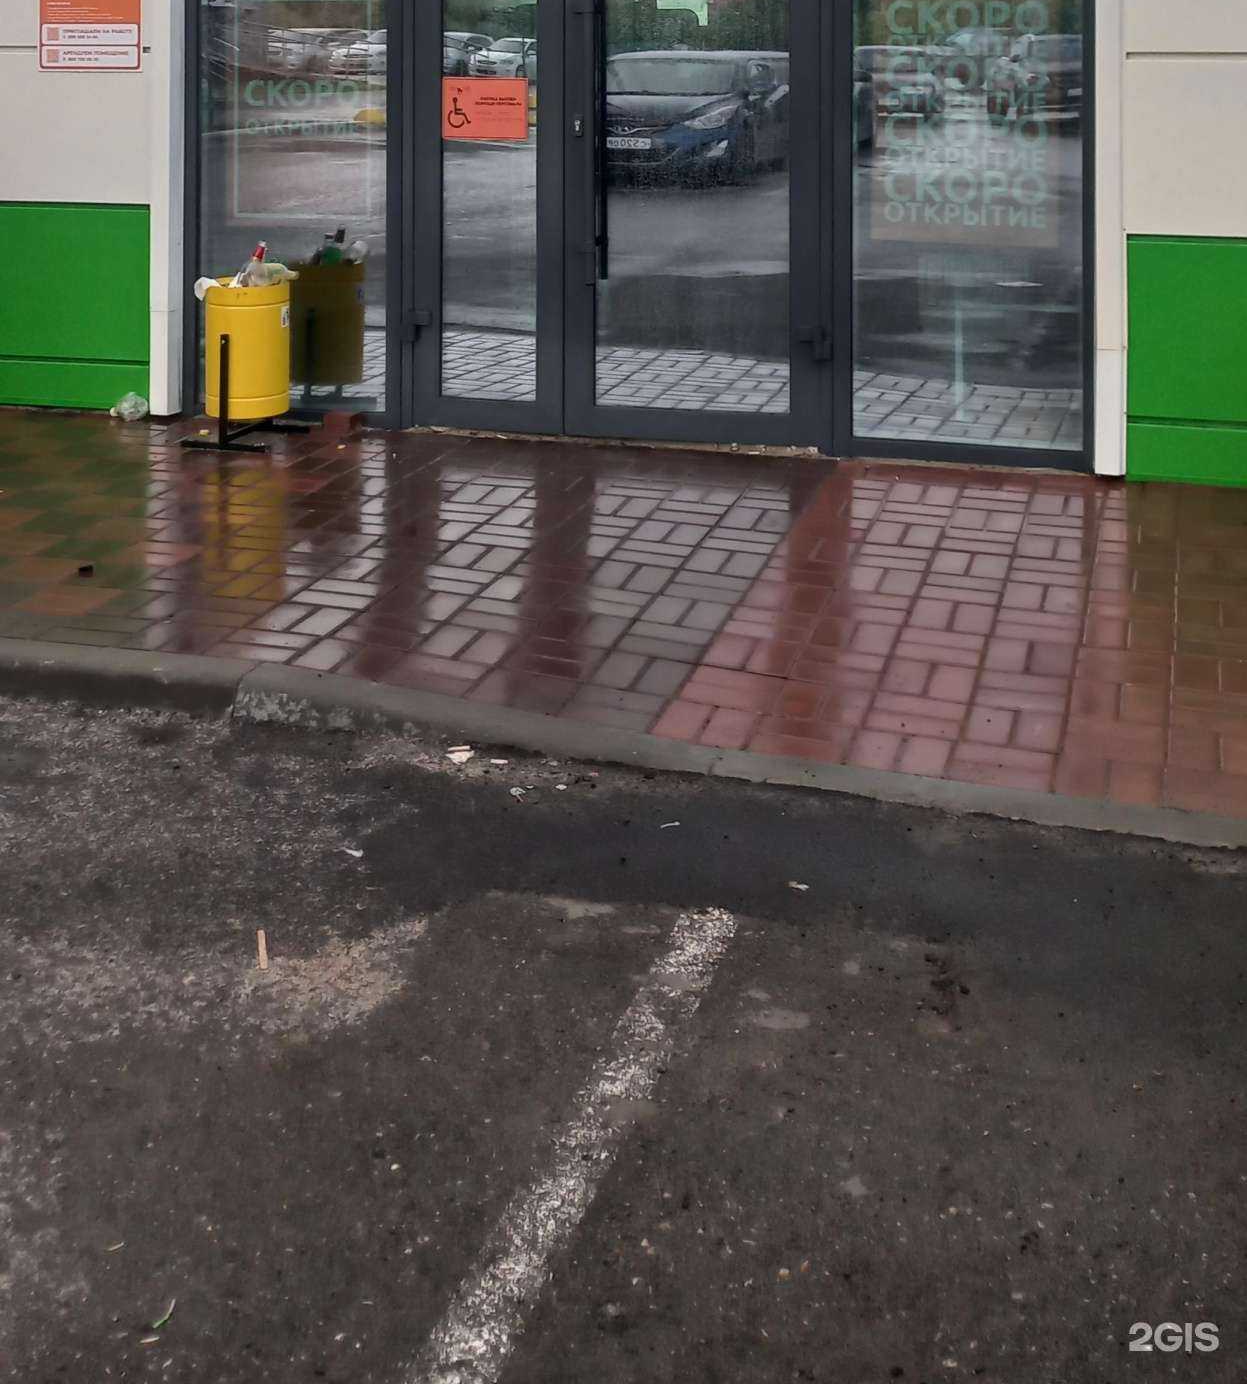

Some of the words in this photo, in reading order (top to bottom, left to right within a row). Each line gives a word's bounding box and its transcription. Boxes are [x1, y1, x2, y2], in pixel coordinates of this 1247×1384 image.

[886, 0, 1049, 35] СКОРО
[244, 79, 360, 108] СКОРО
[884, 115, 1048, 149] СКОРО
[884, 168, 1048, 204] СКОРО
[884, 202, 1048, 229] ОТКРЫТИЕ
